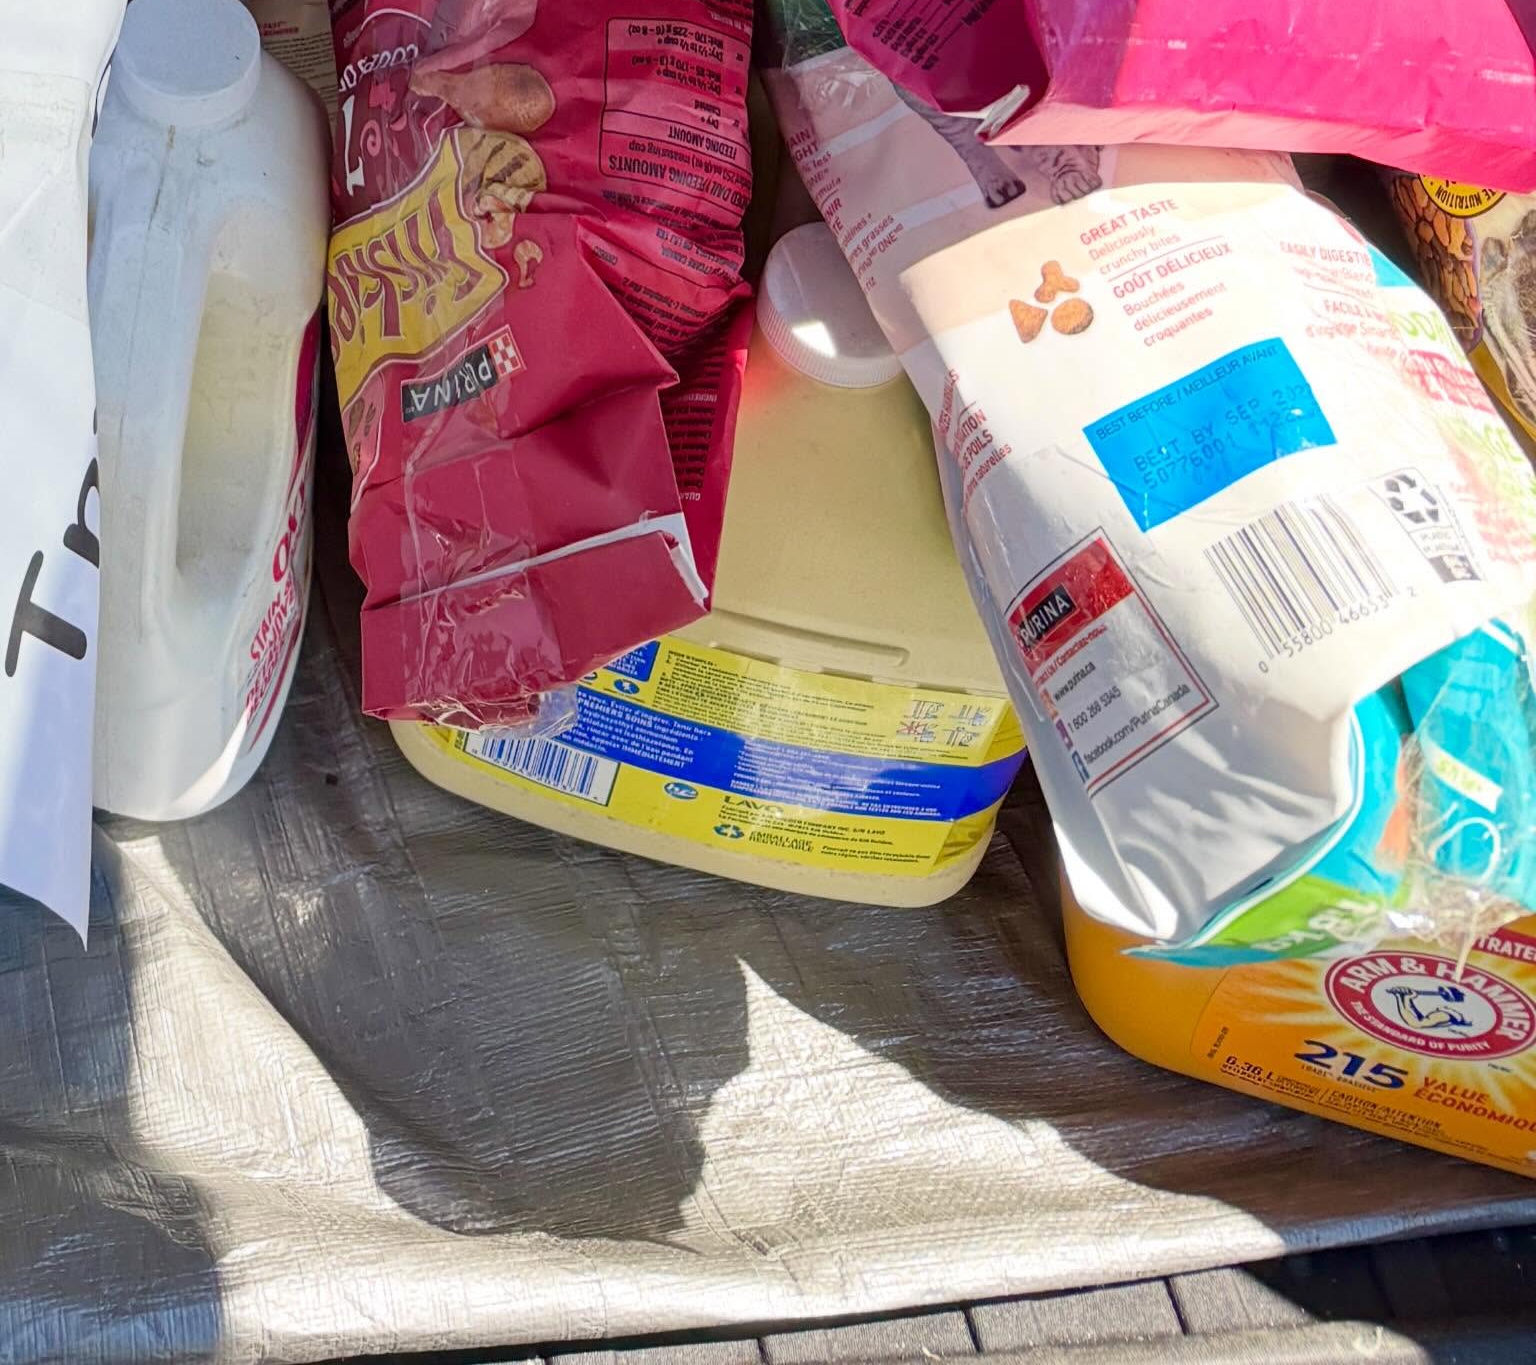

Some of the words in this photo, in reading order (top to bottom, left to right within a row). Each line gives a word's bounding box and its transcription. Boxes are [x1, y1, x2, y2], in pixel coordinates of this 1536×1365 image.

[667, 125, 704, 146] AMOUNT
[608, 155, 665, 180] AMOUNTS
[1080, 214, 1129, 246] GREAT
[1129, 198, 1179, 224] TASTE
[1088, 223, 1157, 262] Deliciously
[1099, 246, 1148, 276] crunchy
[1149, 233, 1181, 252] bites
[1112, 270, 1154, 299] GOÛT
[1155, 241, 1233, 279] DÉLICIEUX
[1123, 281, 1185, 316] Bouchées
[1133, 282, 1228, 332] délicieusement
[1143, 306, 1213, 348] croquantes
[408, 351, 495, 416] PURINA
[1096, 418, 1128, 441] BEST
[1128, 394, 1175, 423] BEFORE
[1182, 360, 1241, 399] MEILLEUR
[1242, 344, 1279, 367] AVANT
[1133, 438, 1182, 473] BEST
[1191, 420, 1215, 446] BY
[1225, 397, 1261, 427] SEP
[1020, 594, 1071, 644] PURINA
[1281, 620, 1334, 659] 55800
[1336, 591, 1391, 627] 46653
[577, 696, 624, 719] PREMIERS
[625, 712, 654, 728] SOINS
[1072, 711, 1090, 731] 800
[1100, 684, 1123, 708] 5345
[1083, 683, 1192, 765] facebook.com/PurinaCanada
[1339, 957, 1397, 993] ARM
[1399, 955, 1426, 975] &
[1436, 961, 1532, 1042] HAMMER
[1360, 1013, 1426, 1049] STANDARD
[1429, 1040, 1446, 1052] OF
[1447, 1039, 1491, 1053] PURITY
[1294, 1039, 1410, 1090] 215
[1412, 1088, 1536, 1135] ÉCONOMIQ
[1422, 1075, 1491, 1105] VALUE
